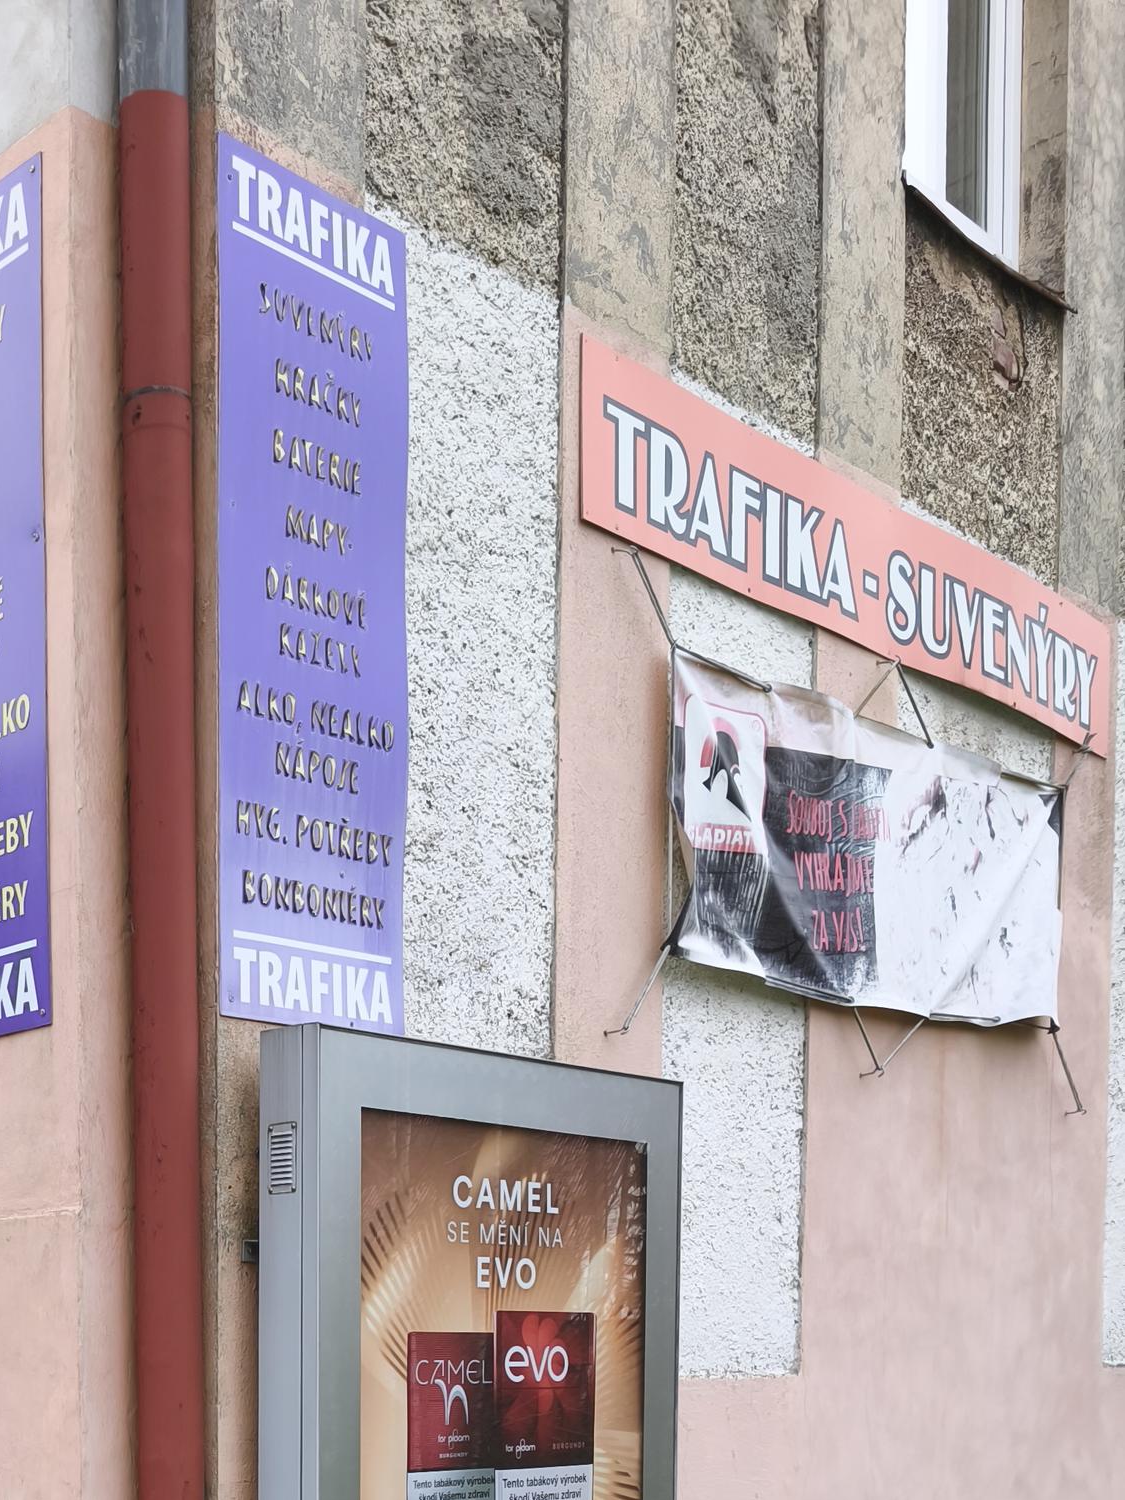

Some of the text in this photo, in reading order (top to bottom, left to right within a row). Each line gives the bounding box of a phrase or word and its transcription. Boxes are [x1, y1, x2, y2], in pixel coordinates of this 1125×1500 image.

[232, 154, 395, 297] TRAFIKA
[274, 357, 362, 429] HRAČKY
[273, 428, 363, 498] BATERIE
[285, 504, 350, 555] MAPY
[603, 394, 859, 623] TRAFIKA
[886, 549, 1098, 731] SUVENÝRY
[279, 621, 362, 679] KAZETY
[296, 814, 393, 869] POTŘEBY
[786, 789, 833, 843] SOUBOJ
[838, 800, 848, 838] S
[242, 868, 386, 932] BONBONIÉRY
[232, 946, 394, 1026] TRAFIKA
[452, 1175, 560, 1215] CAMEL
[447, 1220, 564, 1249] SE MĚNÍ NA
[476, 1256, 537, 1290] EVO
[415, 1359, 493, 1385] CAMEL
[504, 1345, 569, 1383] evo
[413, 1478, 433, 1490] Tento
[433, 1476, 466, 1489] tabákový
[438, 1489, 467, 1500] Vašemu
[502, 1471, 588, 1490] Tento tabákový výrobek
[561, 1488, 582, 1500] zdraví
